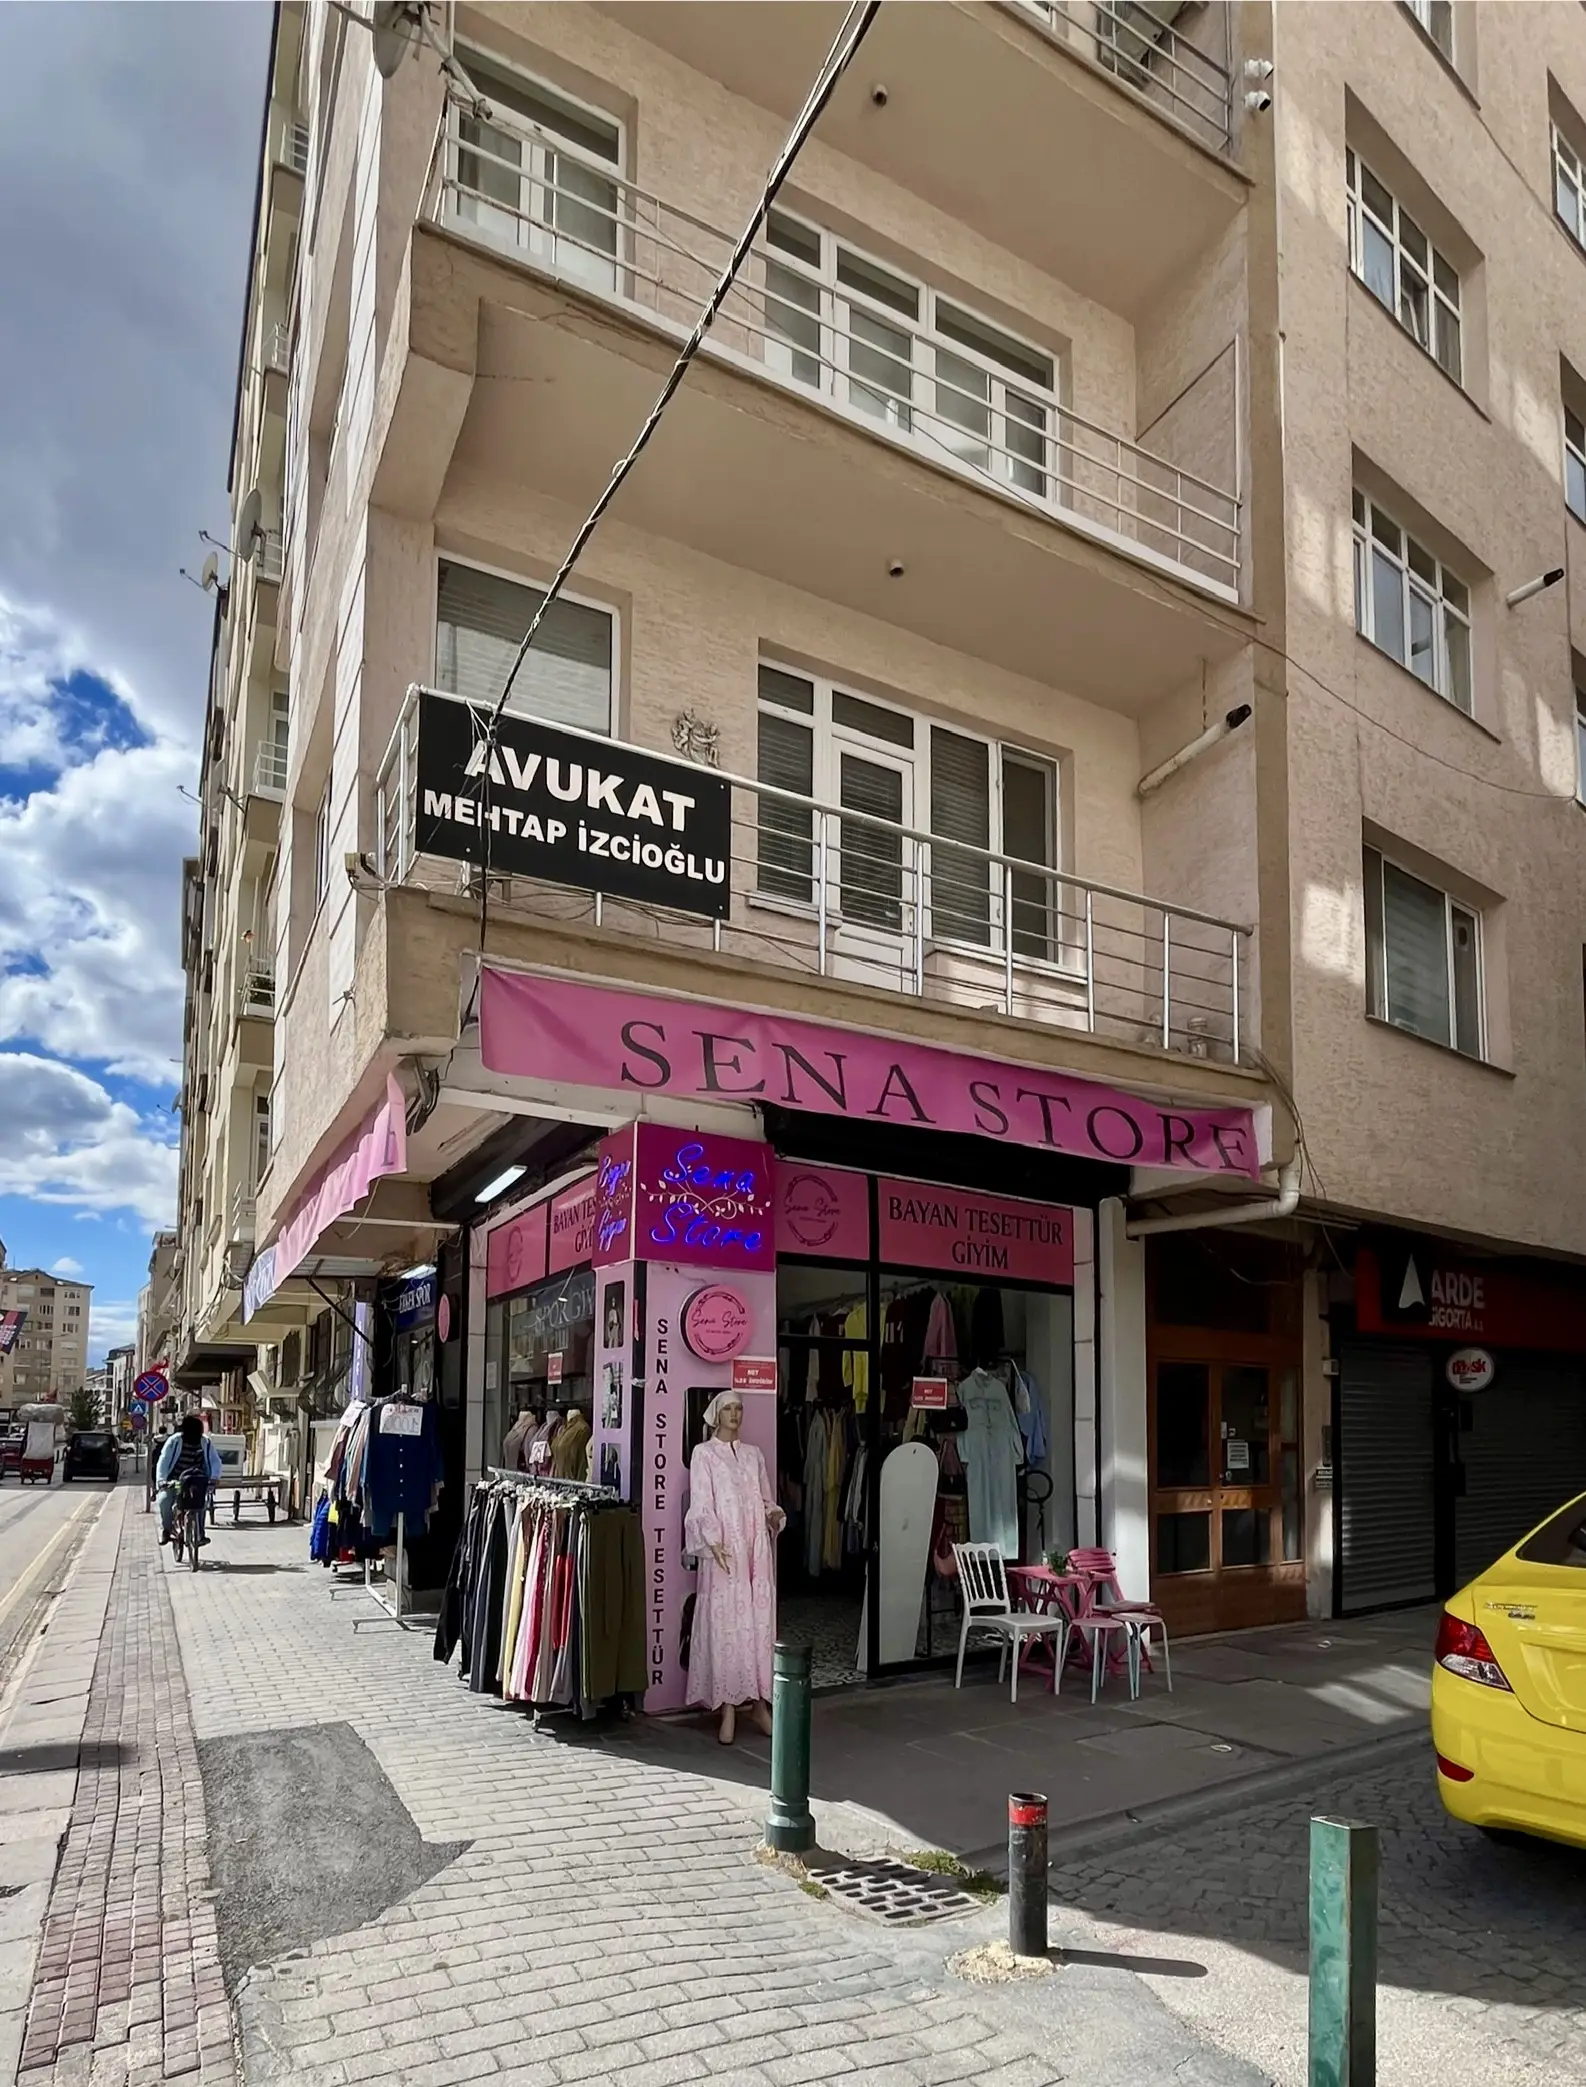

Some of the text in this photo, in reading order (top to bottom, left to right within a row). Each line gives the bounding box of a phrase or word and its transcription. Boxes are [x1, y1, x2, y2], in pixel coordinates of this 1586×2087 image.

[464, 740, 695, 832] AVUKAT
[424, 789, 725, 884] MEHTAP İZCİOĞLU
[621, 1021, 1251, 1174] SENA STORE
[663, 1143, 754, 1194] Sena
[553, 1203, 580, 1234] BAYAN
[651, 1203, 762, 1251] Store
[889, 1196, 1064, 1245] BAYAN TESETTÜR
[952, 1235, 1009, 1269] GİYİM
[1431, 1269, 1486, 1309] ARDE
[691, 1308, 748, 1328] Sena Store
[652, 1318, 669, 1685] SENA STORE TESETTÜR
